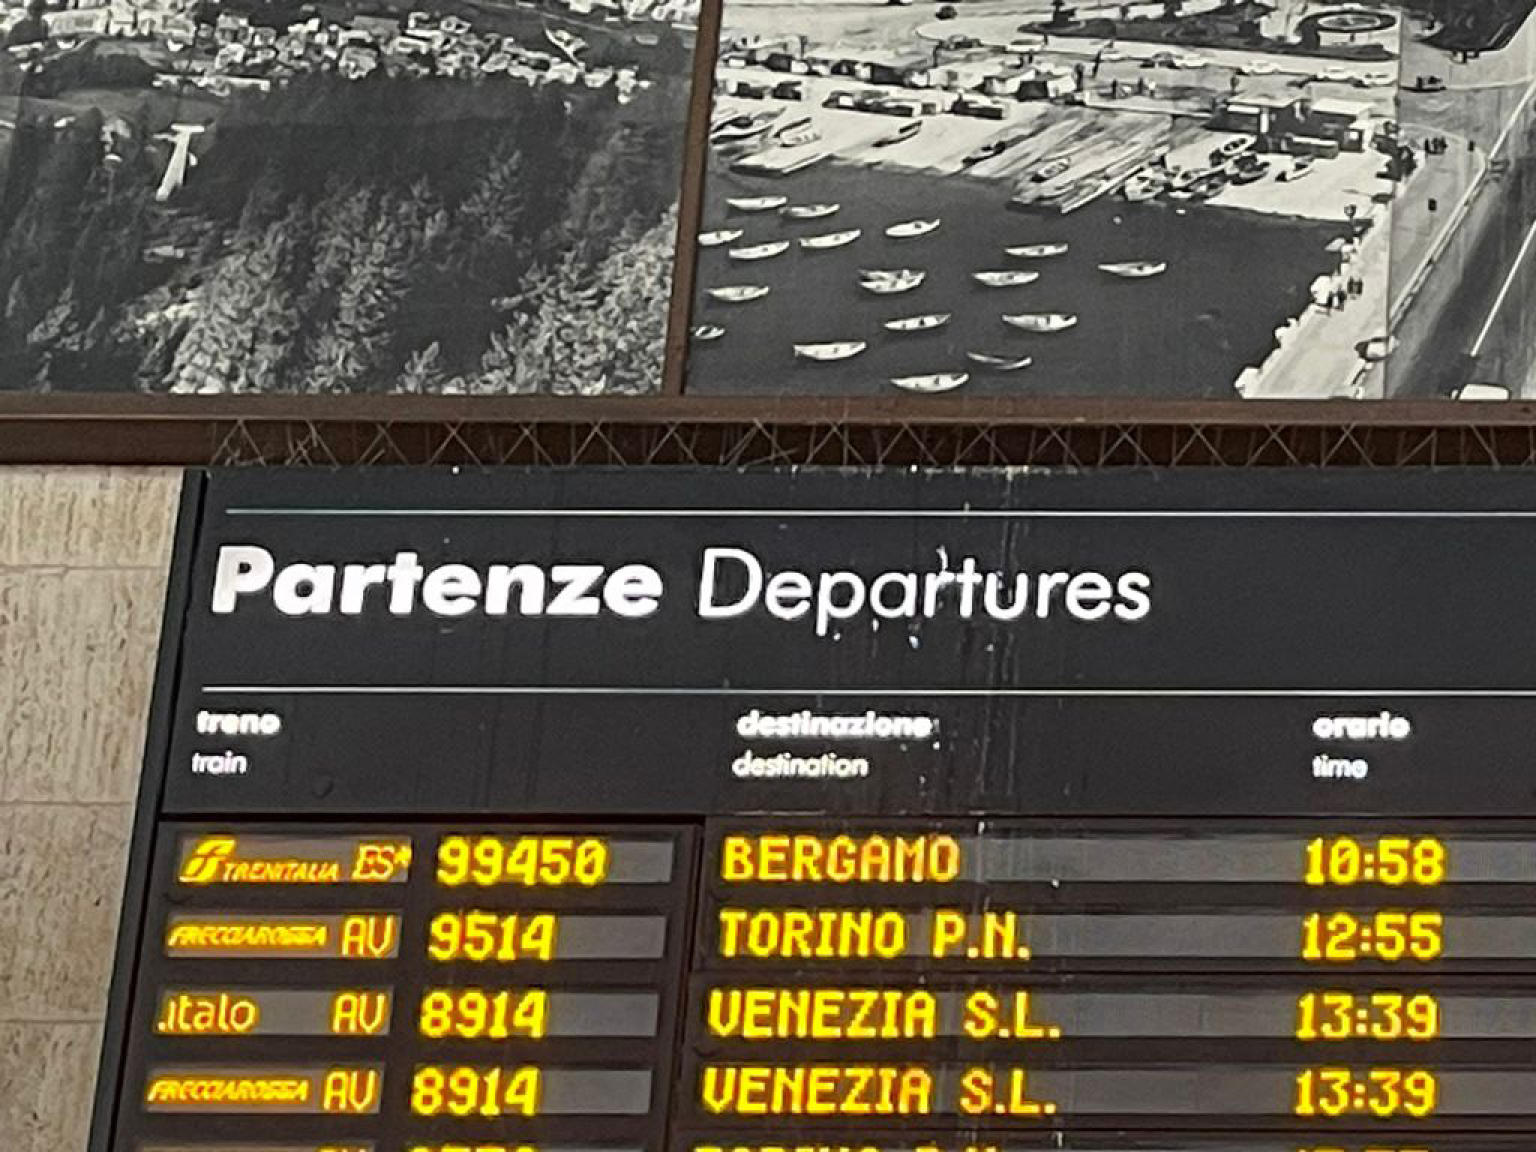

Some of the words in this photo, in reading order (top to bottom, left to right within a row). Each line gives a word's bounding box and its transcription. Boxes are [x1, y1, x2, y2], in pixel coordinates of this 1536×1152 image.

[212, 545, 664, 618] Partenze
[698, 546, 1152, 635] Departures
[196, 710, 281, 735] treno
[736, 709, 932, 739] destinazione
[1312, 710, 1411, 740] orario
[191, 750, 247, 775] train
[731, 749, 869, 778] destination
[1312, 754, 1369, 780] time
[437, 836, 607, 886] 99450
[723, 835, 960, 882] BERGAMO
[1305, 838, 1445, 885] 10:58
[341, 916, 394, 958] AV
[429, 911, 556, 961] 9514
[719, 911, 905, 958] TORINO
[932, 911, 1030, 958] P.N.
[1302, 913, 1442, 959] 12:55
[332, 992, 387, 1035] AV
[420, 991, 546, 1038] 8914
[708, 989, 936, 1038] VENEZIA
[963, 991, 1060, 1038] S.L.
[1296, 993, 1438, 1039] 13:39
[323, 1070, 377, 1113] AV
[411, 1067, 539, 1116] 8914
[703, 1067, 932, 1114] VENEZIA
[959, 1069, 1056, 1114] S.L.
[1295, 1070, 1435, 1116] 13:39
